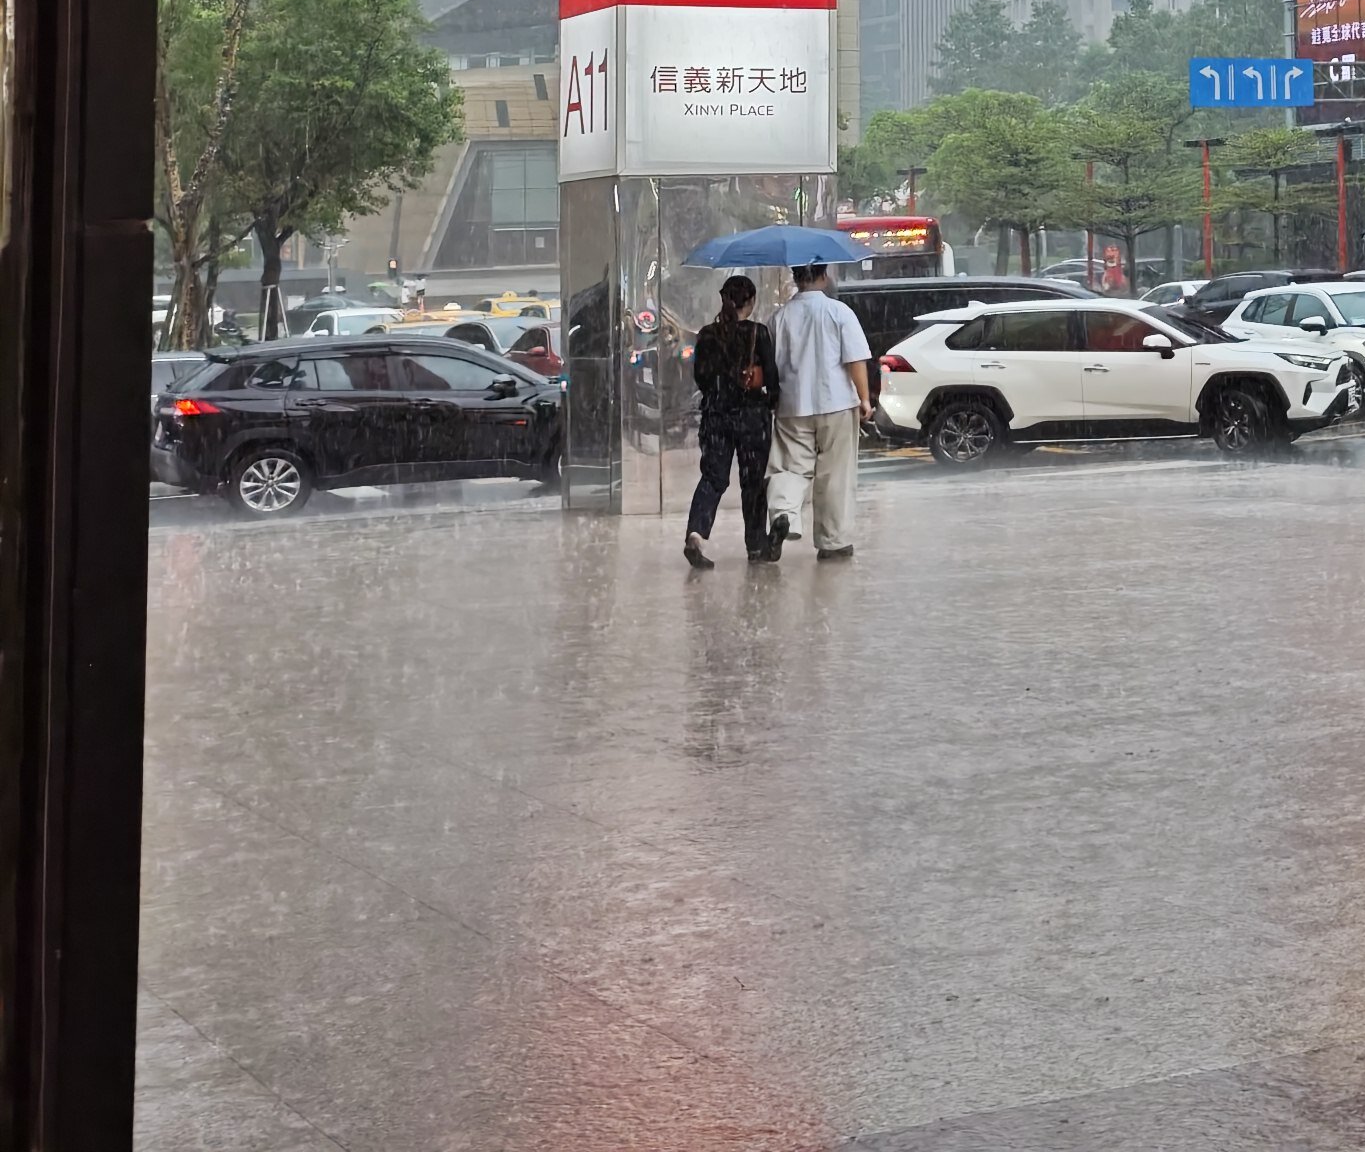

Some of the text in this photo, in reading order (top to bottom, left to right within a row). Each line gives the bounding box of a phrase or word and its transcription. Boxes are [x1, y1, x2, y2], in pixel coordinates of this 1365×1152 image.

[563, 47, 608, 138] A11
[650, 65, 808, 94] 信義新天地
[684, 103, 775, 116] XINYI PLACE
